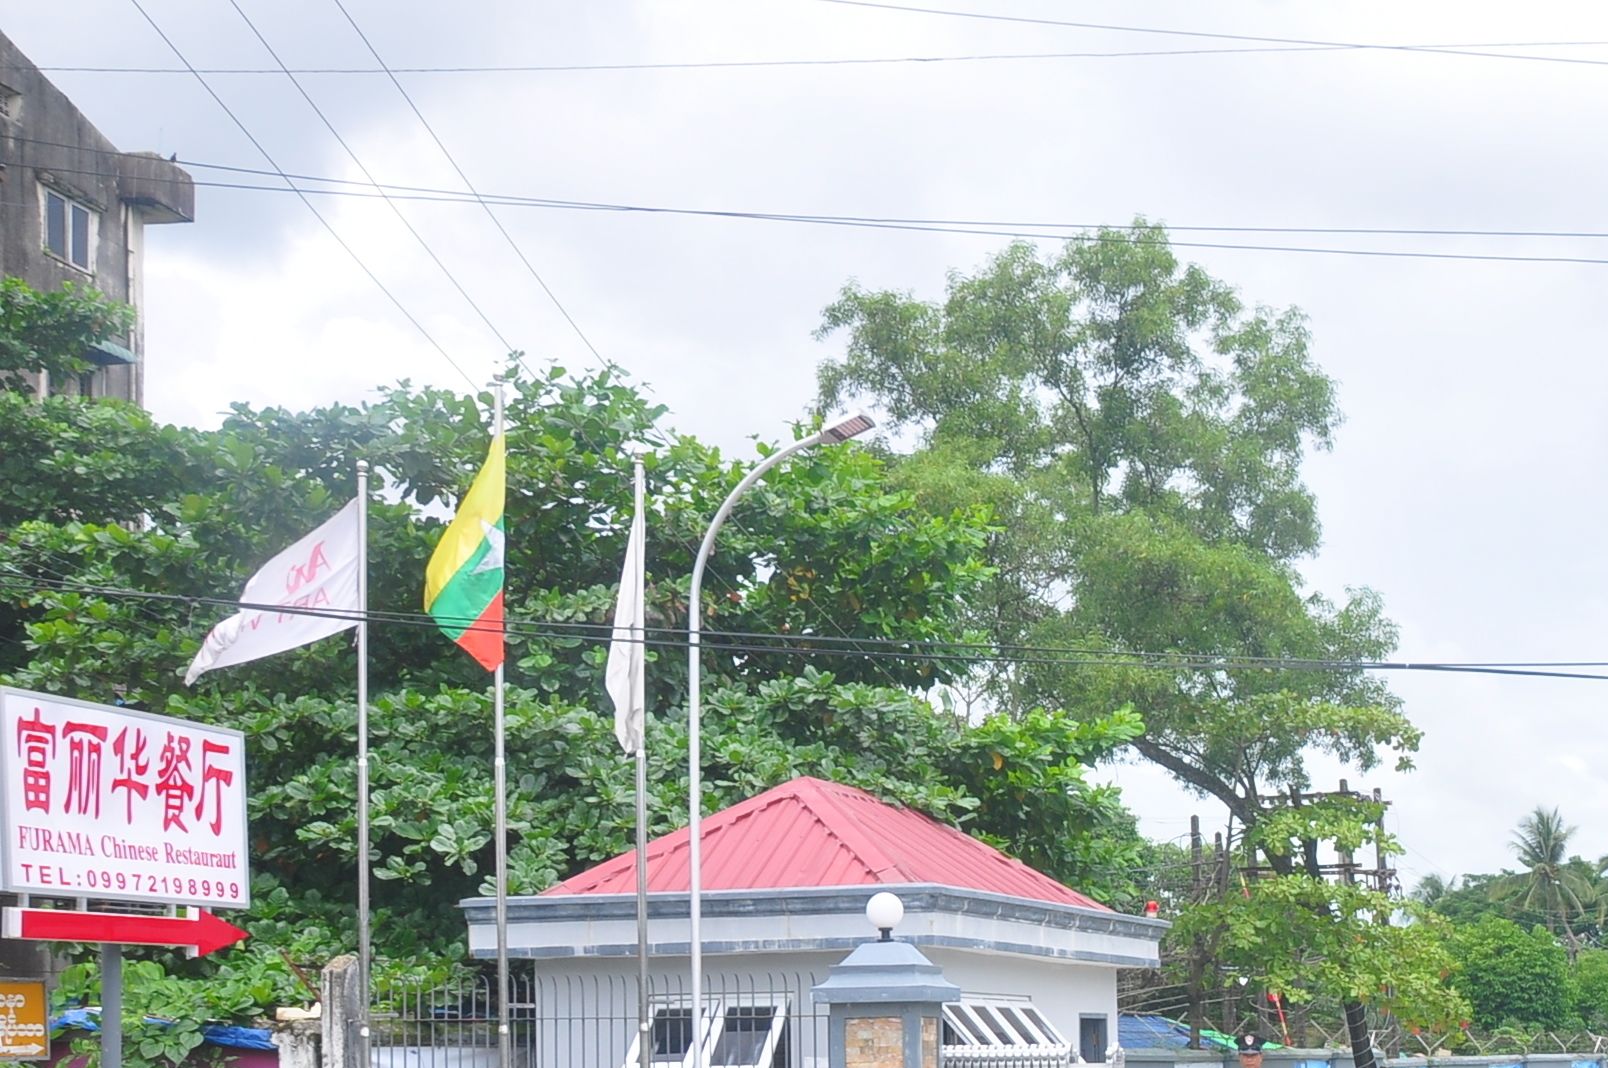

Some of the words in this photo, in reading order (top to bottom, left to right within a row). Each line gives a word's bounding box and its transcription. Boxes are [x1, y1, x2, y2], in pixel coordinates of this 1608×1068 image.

[17, 707, 233, 837] 富丽华餐厅
[18, 825, 96, 857] FURAMA
[101, 835, 159, 862] Chinese
